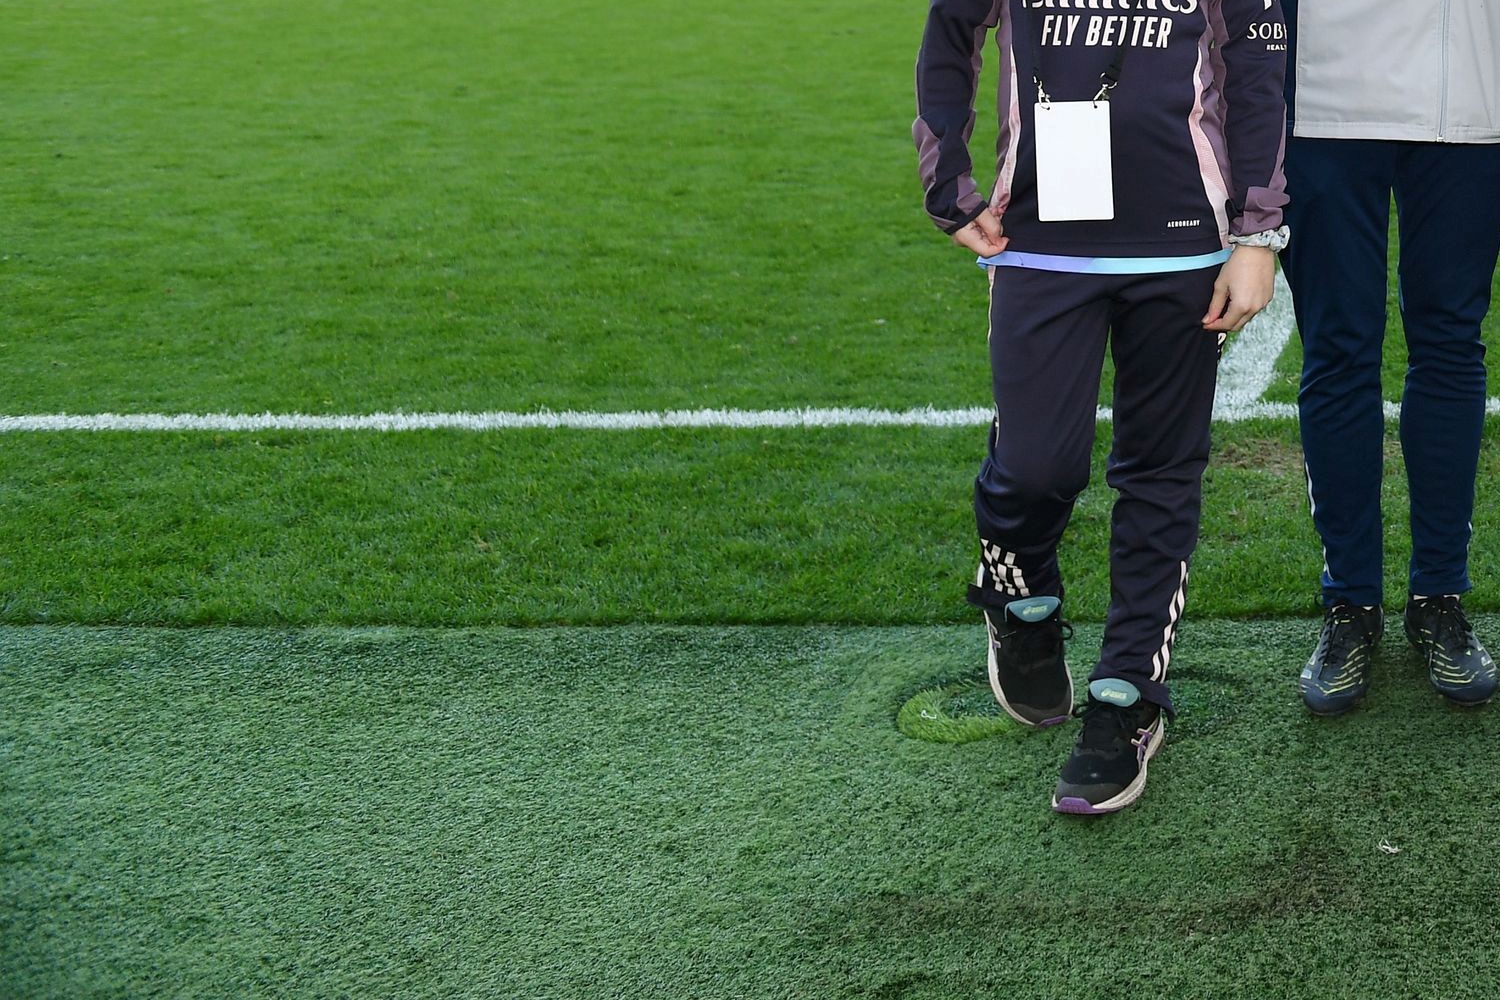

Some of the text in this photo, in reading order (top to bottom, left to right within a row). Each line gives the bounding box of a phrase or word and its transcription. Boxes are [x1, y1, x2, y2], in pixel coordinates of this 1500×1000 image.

[1041, 15, 1172, 49] FLY BETTER
[1247, 22, 1287, 40] SOB
